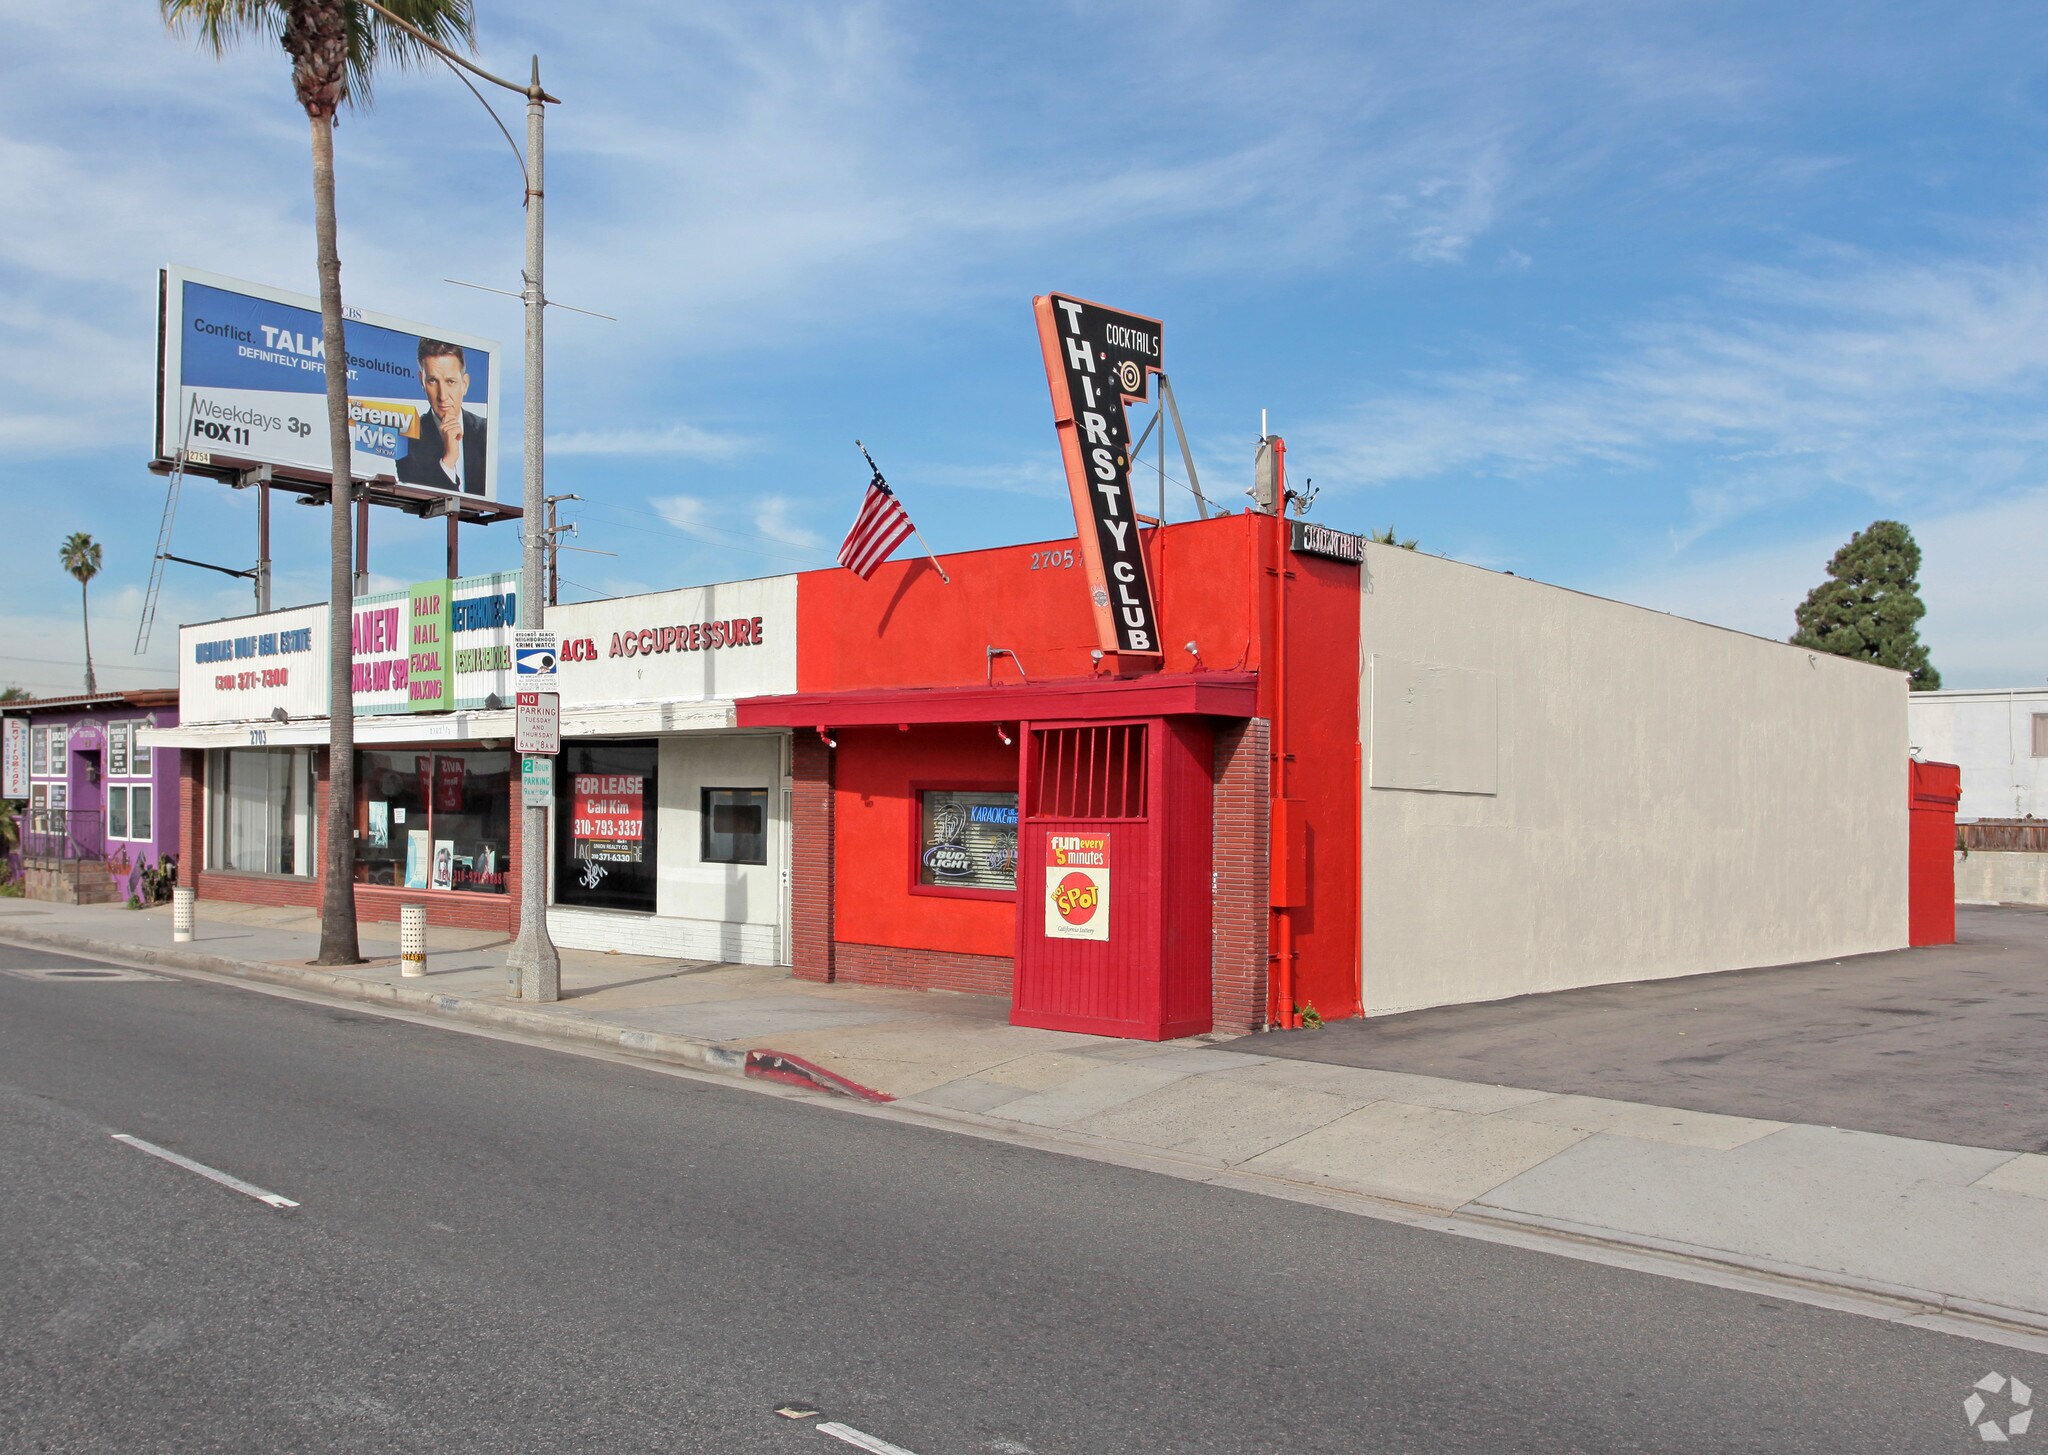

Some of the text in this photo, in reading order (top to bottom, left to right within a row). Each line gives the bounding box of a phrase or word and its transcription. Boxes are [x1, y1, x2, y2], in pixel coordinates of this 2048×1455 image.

[342, 307, 362, 319] CBS
[194, 318, 414, 378] Conflict. TALK Resolution.
[238, 346, 298, 368] DEFINITELY
[194, 398, 311, 438] Weekdays 3p
[194, 419, 249, 446] FOX 11
[356, 424, 396, 449] Kyle
[190, 451, 208, 462] 2754
[1058, 300, 1150, 650] THIRSTY CLUB
[1030, 550, 1074, 570] 2705
[414, 594, 440, 617] HAIR
[352, 607, 399, 655] ANEW
[414, 623, 439, 645] NAIL
[608, 616, 762, 658] ACCUPRESSURE
[196, 627, 312, 664] NICHOLAS WOLF REAL ESTATE
[410, 652, 441, 673] FACIAL
[215, 668, 289, 691] (310) 371-7300
[365, 662, 372, 692] &
[373, 661, 392, 691] DAY
[410, 680, 442, 700] WAXING
[521, 694, 535, 704] NO
[520, 707, 556, 716] PARKING
[250, 730, 266, 745] 2703
[524, 761, 532, 771] 2
[524, 777, 550, 785] PARKING
[575, 777, 643, 794] FOR LEASE
[588, 799, 629, 814] Call Kim
[971, 806, 1008, 824] KARAOKE
[574, 819, 642, 836] 310-793-3337
[1051, 836, 1104, 850] fun every
[599, 853, 630, 862] 371-6330
[930, 858, 970, 870] LIGHT
[936, 851, 966, 860] BUD
[1056, 847, 1103, 865] 5 minutes
[1051, 884, 1065, 902] HOT
[1058, 886, 1099, 915] SPOT
[1058, 926, 1079, 934] California
[1079, 927, 1094, 935] Lottery
